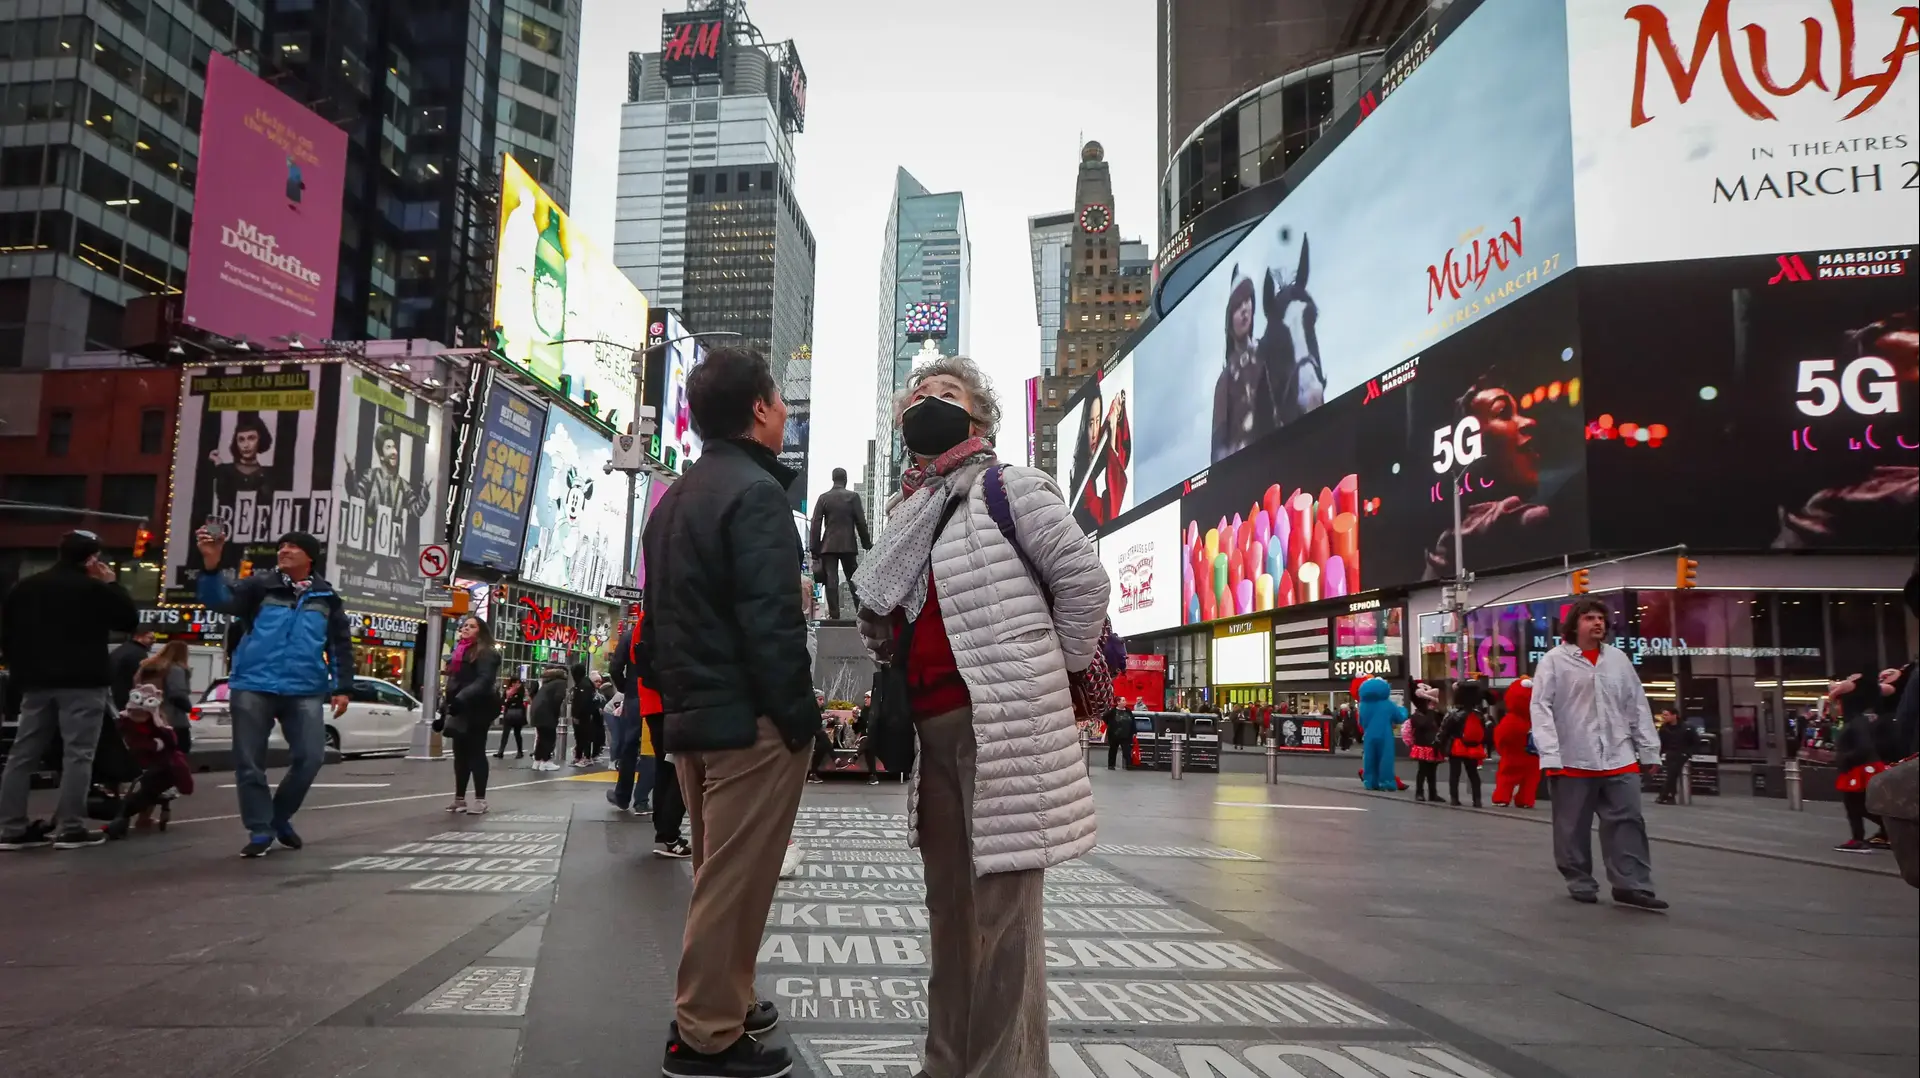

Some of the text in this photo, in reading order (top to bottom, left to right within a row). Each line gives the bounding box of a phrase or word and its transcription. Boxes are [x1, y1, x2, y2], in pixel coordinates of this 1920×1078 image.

[664, 20, 724, 61] H&M
[1381, 23, 1438, 87] MARRIOTT
[1624, 0, 1919, 128] MULA
[1382, 46, 1431, 100] MARQUIS
[1752, 134, 1908, 160] IN THEATRES
[1712, 160, 1919, 204] MARCH 2
[237, 218, 279, 248] Mrs.
[1159, 222, 1195, 261] MARRIOTT
[220, 225, 321, 286] Doubtfire
[1159, 238, 1190, 272] MARQUIS
[1426, 216, 1523, 314] MULAN
[1818, 249, 1912, 265] MARRIOTT
[1484, 266, 1538, 305] MARCH
[1542, 253, 1560, 277] 27
[1818, 263, 1902, 278] MARQUIS
[650, 337, 662, 346] LG
[1381, 356, 1420, 382] MARRIOTT
[1382, 369, 1416, 392] MARQUIS
[1796, 356, 1899, 417] 5G
[486, 438, 531, 476] COME
[1432, 415, 1483, 474] 5G
[477, 482, 525, 514] AWAY
[625, 590, 638, 598] WAY
[1349, 599, 1380, 612] SEPHORA
[138, 609, 180, 624] IFTS
[370, 616, 419, 635] LUGGAGE
[1629, 637, 1646, 649] 5G
[1651, 637, 1672, 650] ON
[1334, 658, 1391, 676] SEPHORA
[1301, 726, 1322, 736] ERIKA
[1301, 735, 1322, 745] JAYNE
[330, 856, 553, 872] PALACE
[408, 874, 557, 891] CORT
[777, 881, 927, 892] BARRYMO
[424, 968, 498, 1012] WINTER
[462, 968, 522, 1012] GARDEN
[775, 977, 929, 999] CIRC
[790, 998, 819, 1018] IN
[829, 999, 885, 1019] THE
